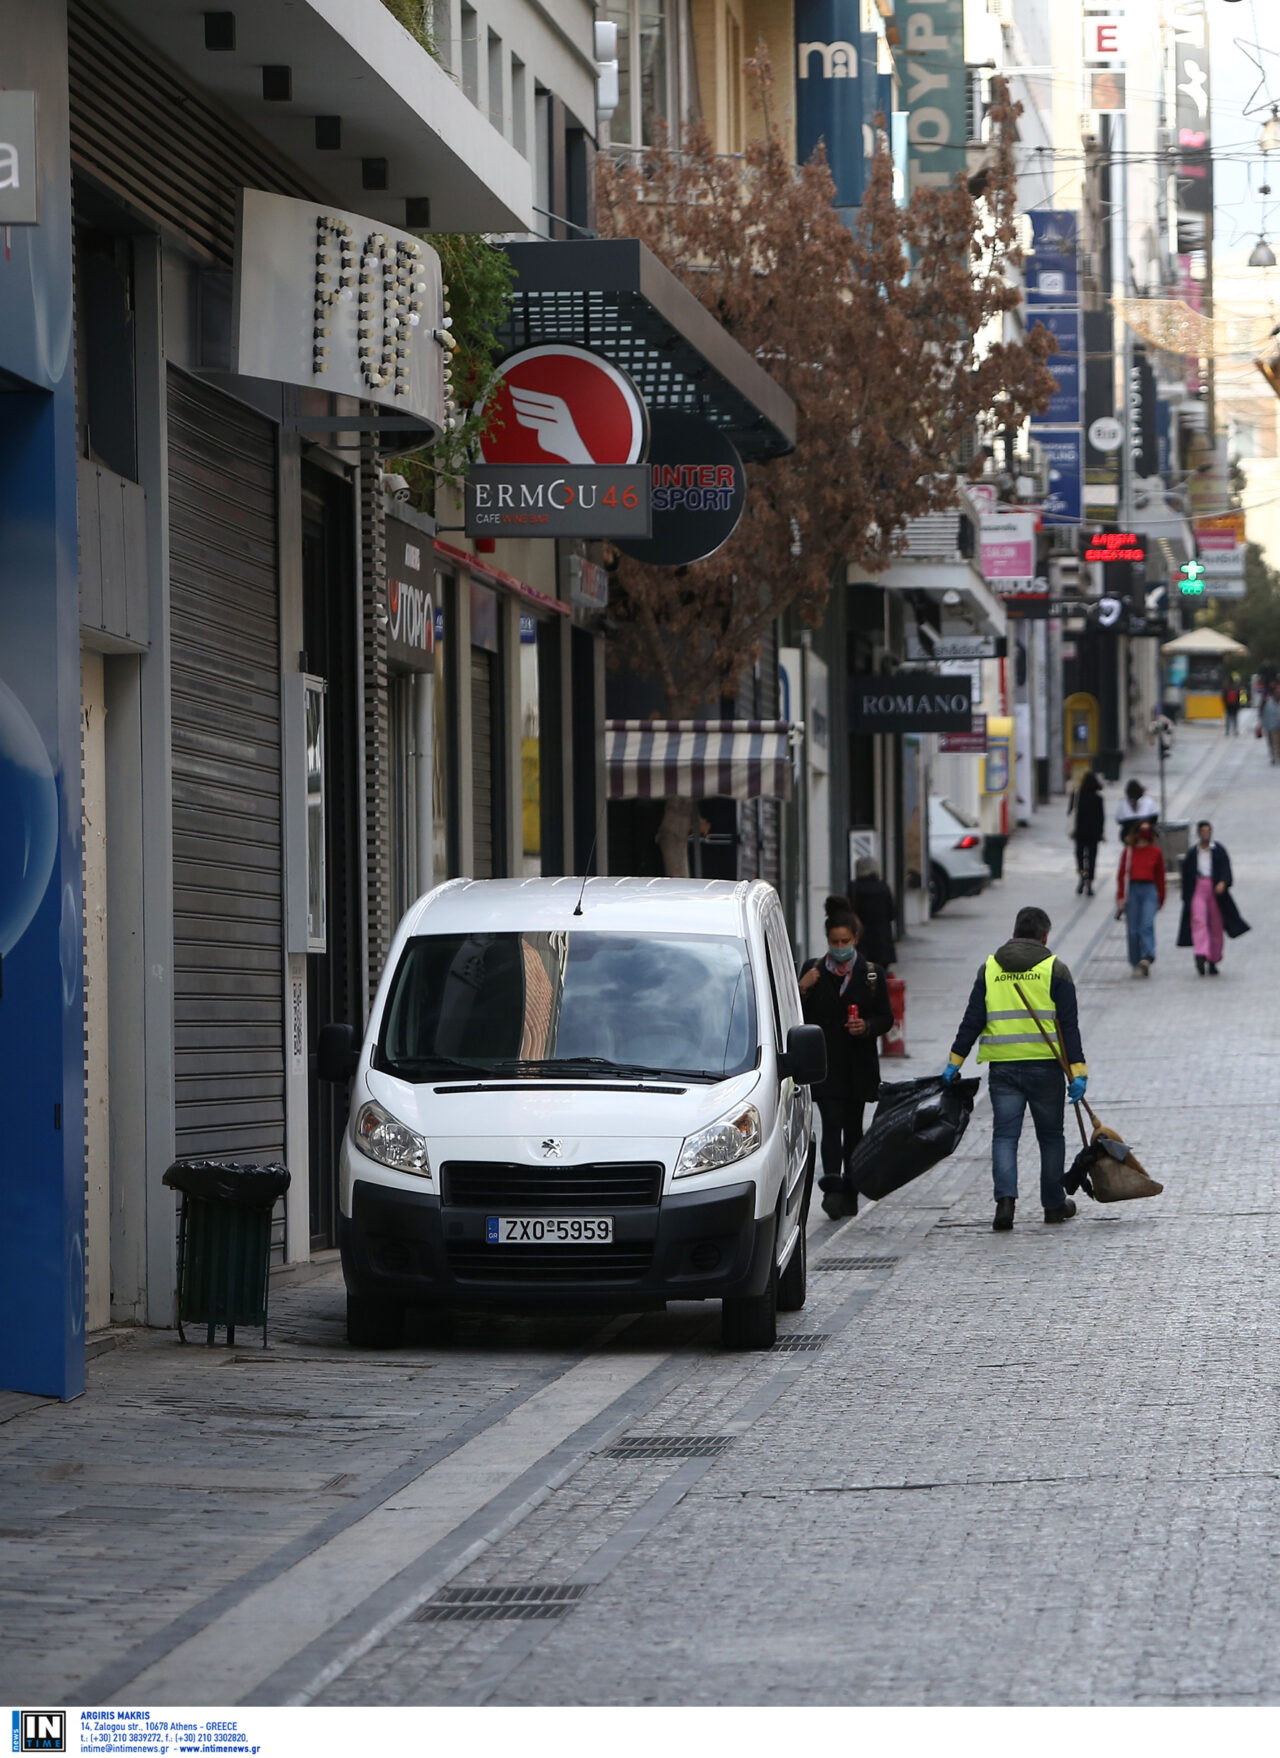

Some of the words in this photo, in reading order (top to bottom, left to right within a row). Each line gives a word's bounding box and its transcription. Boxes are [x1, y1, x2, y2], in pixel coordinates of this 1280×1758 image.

[652, 464, 735, 488] INTER
[475, 479, 597, 510] ERMOU
[601, 485, 639, 509] 46
[651, 487, 735, 512] SPORT
[475, 513, 501, 525] CAFE
[502, 513, 527, 525] WINE
[529, 513, 549, 525] BAR
[862, 694, 969, 714] ROMANO
